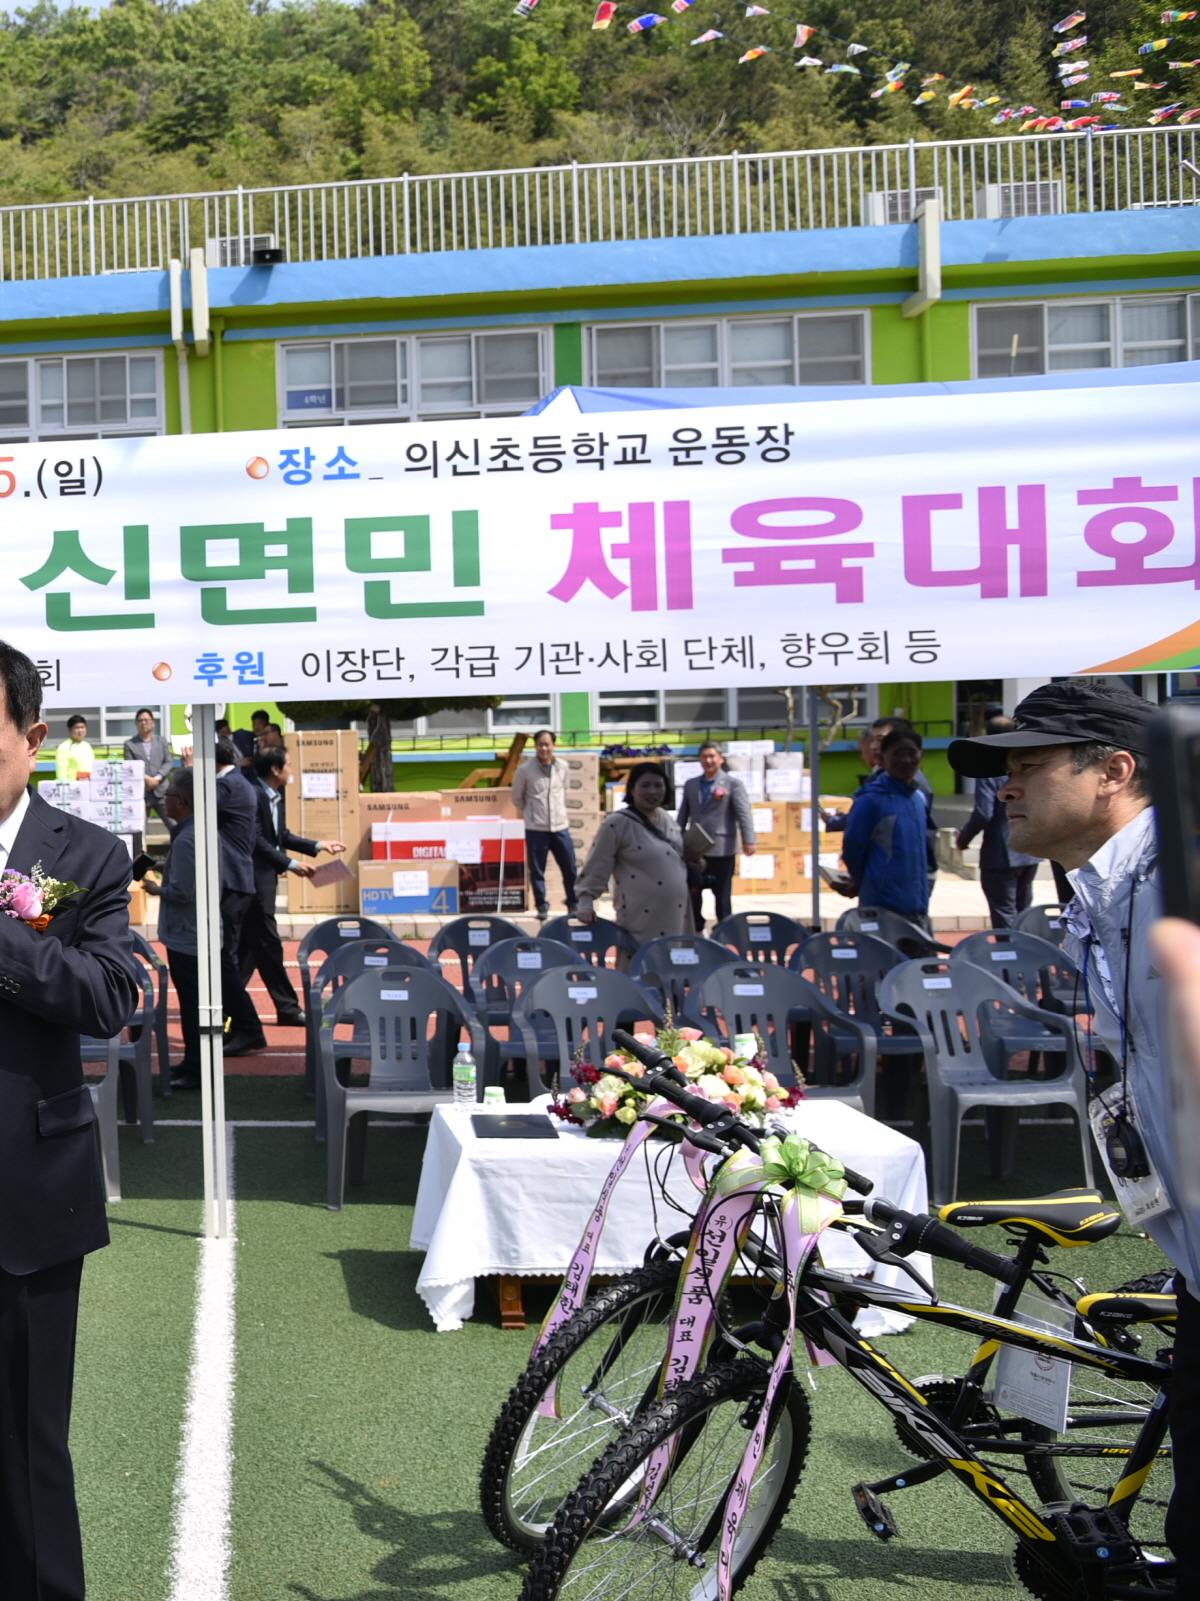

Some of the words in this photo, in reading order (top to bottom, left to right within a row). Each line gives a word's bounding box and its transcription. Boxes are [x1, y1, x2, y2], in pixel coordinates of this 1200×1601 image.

[404, 430, 652, 479] 의신초등학교
[668, 422, 795, 467] 운동장
[546, 476, 1200, 612] 체육대회
[301, 647, 415, 683] 이장단,
[430, 645, 500, 679] 각급
[683, 634, 766, 671] 단체,
[780, 630, 891, 668] 향우회
[904, 630, 941, 665] 등
[296, 739, 334, 747] SAMSUNG
[455, 795, 497, 803] SAMSUNG
[367, 802, 410, 811] SAMSUNG
[412, 846, 446, 858] DIGITA
[1100, 1310, 1134, 1319] K2BIKE
[676, 1315, 696, 1343] 대표
